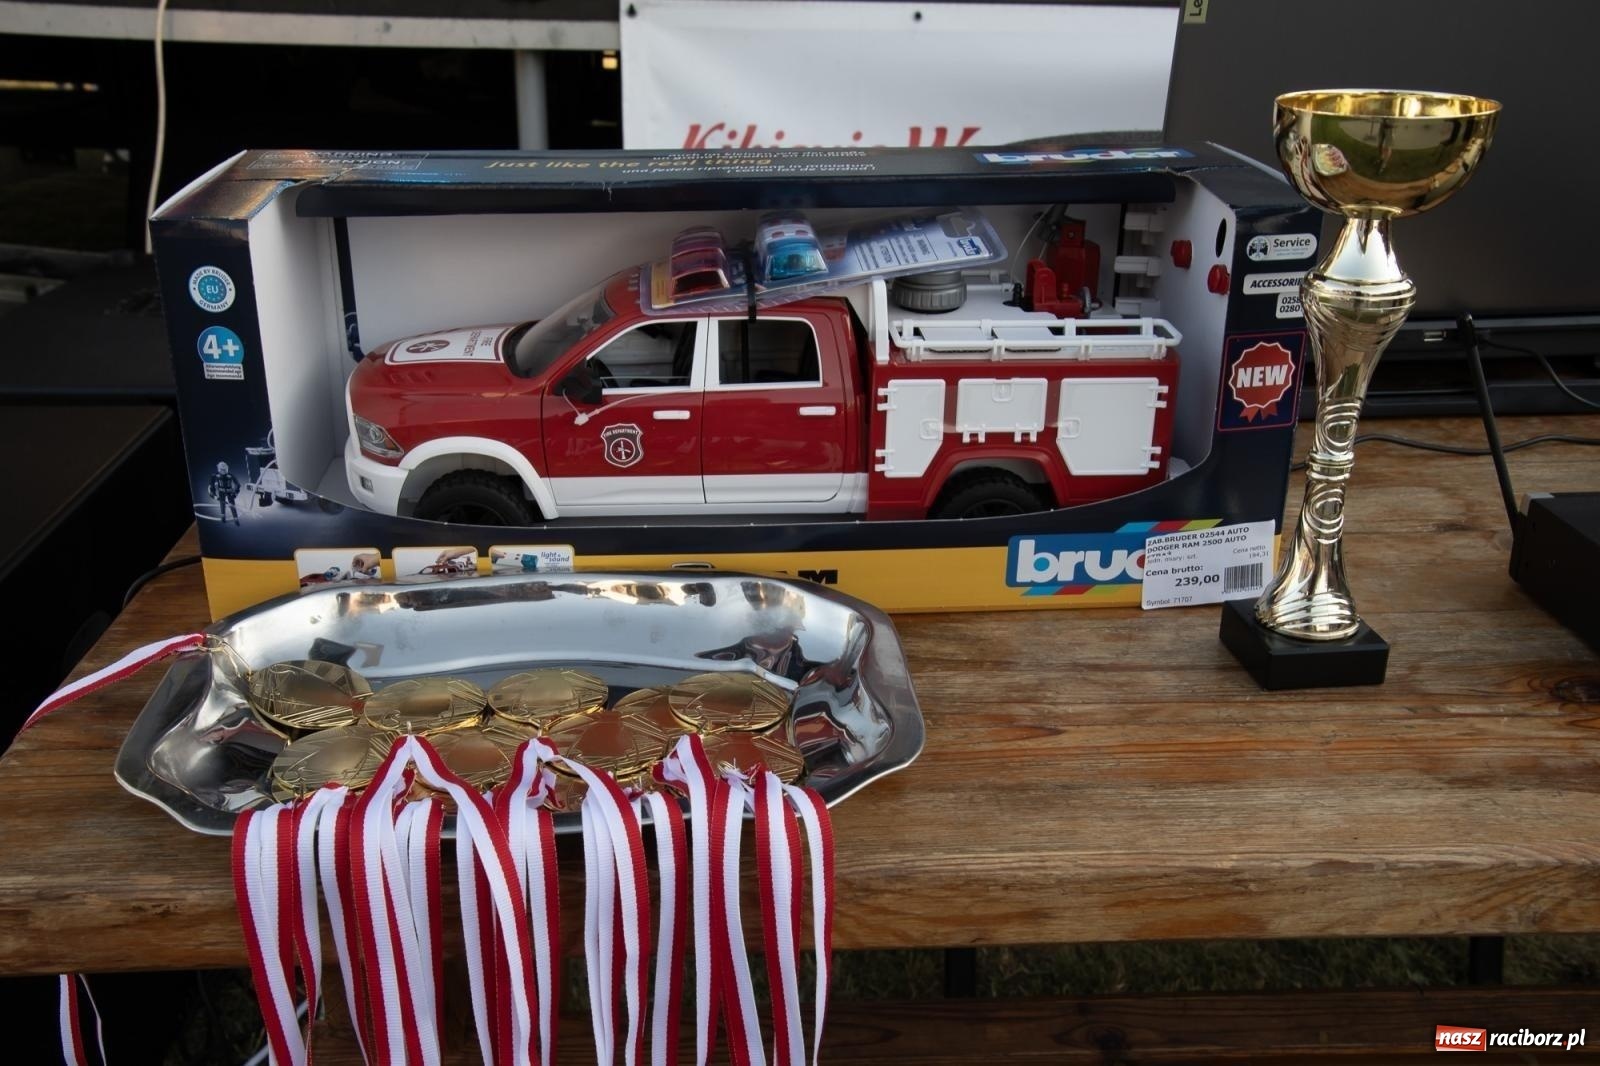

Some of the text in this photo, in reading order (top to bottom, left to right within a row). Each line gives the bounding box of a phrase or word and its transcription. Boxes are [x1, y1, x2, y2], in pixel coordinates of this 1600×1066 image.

[545, 160, 591, 169] like
[599, 160, 641, 168] the
[648, 159, 697, 168] real
[705, 157, 772, 167] thing
[983, 150, 1179, 164] bruder
[1273, 238, 1311, 249] Service
[206, 285, 219, 294] EU
[1250, 277, 1302, 289] ACCESSORI
[203, 334, 240, 360] 4+
[1236, 364, 1289, 389] NEW
[1199, 530, 1225, 539] 02544
[1227, 526, 1250, 535] AUTO
[1182, 541, 1200, 549] RAM
[1202, 538, 1223, 547] 2500
[1224, 535, 1247, 543] AUTO
[1145, 565, 1204, 577] Cena brutto:
[1174, 574, 1220, 587] 239,00
